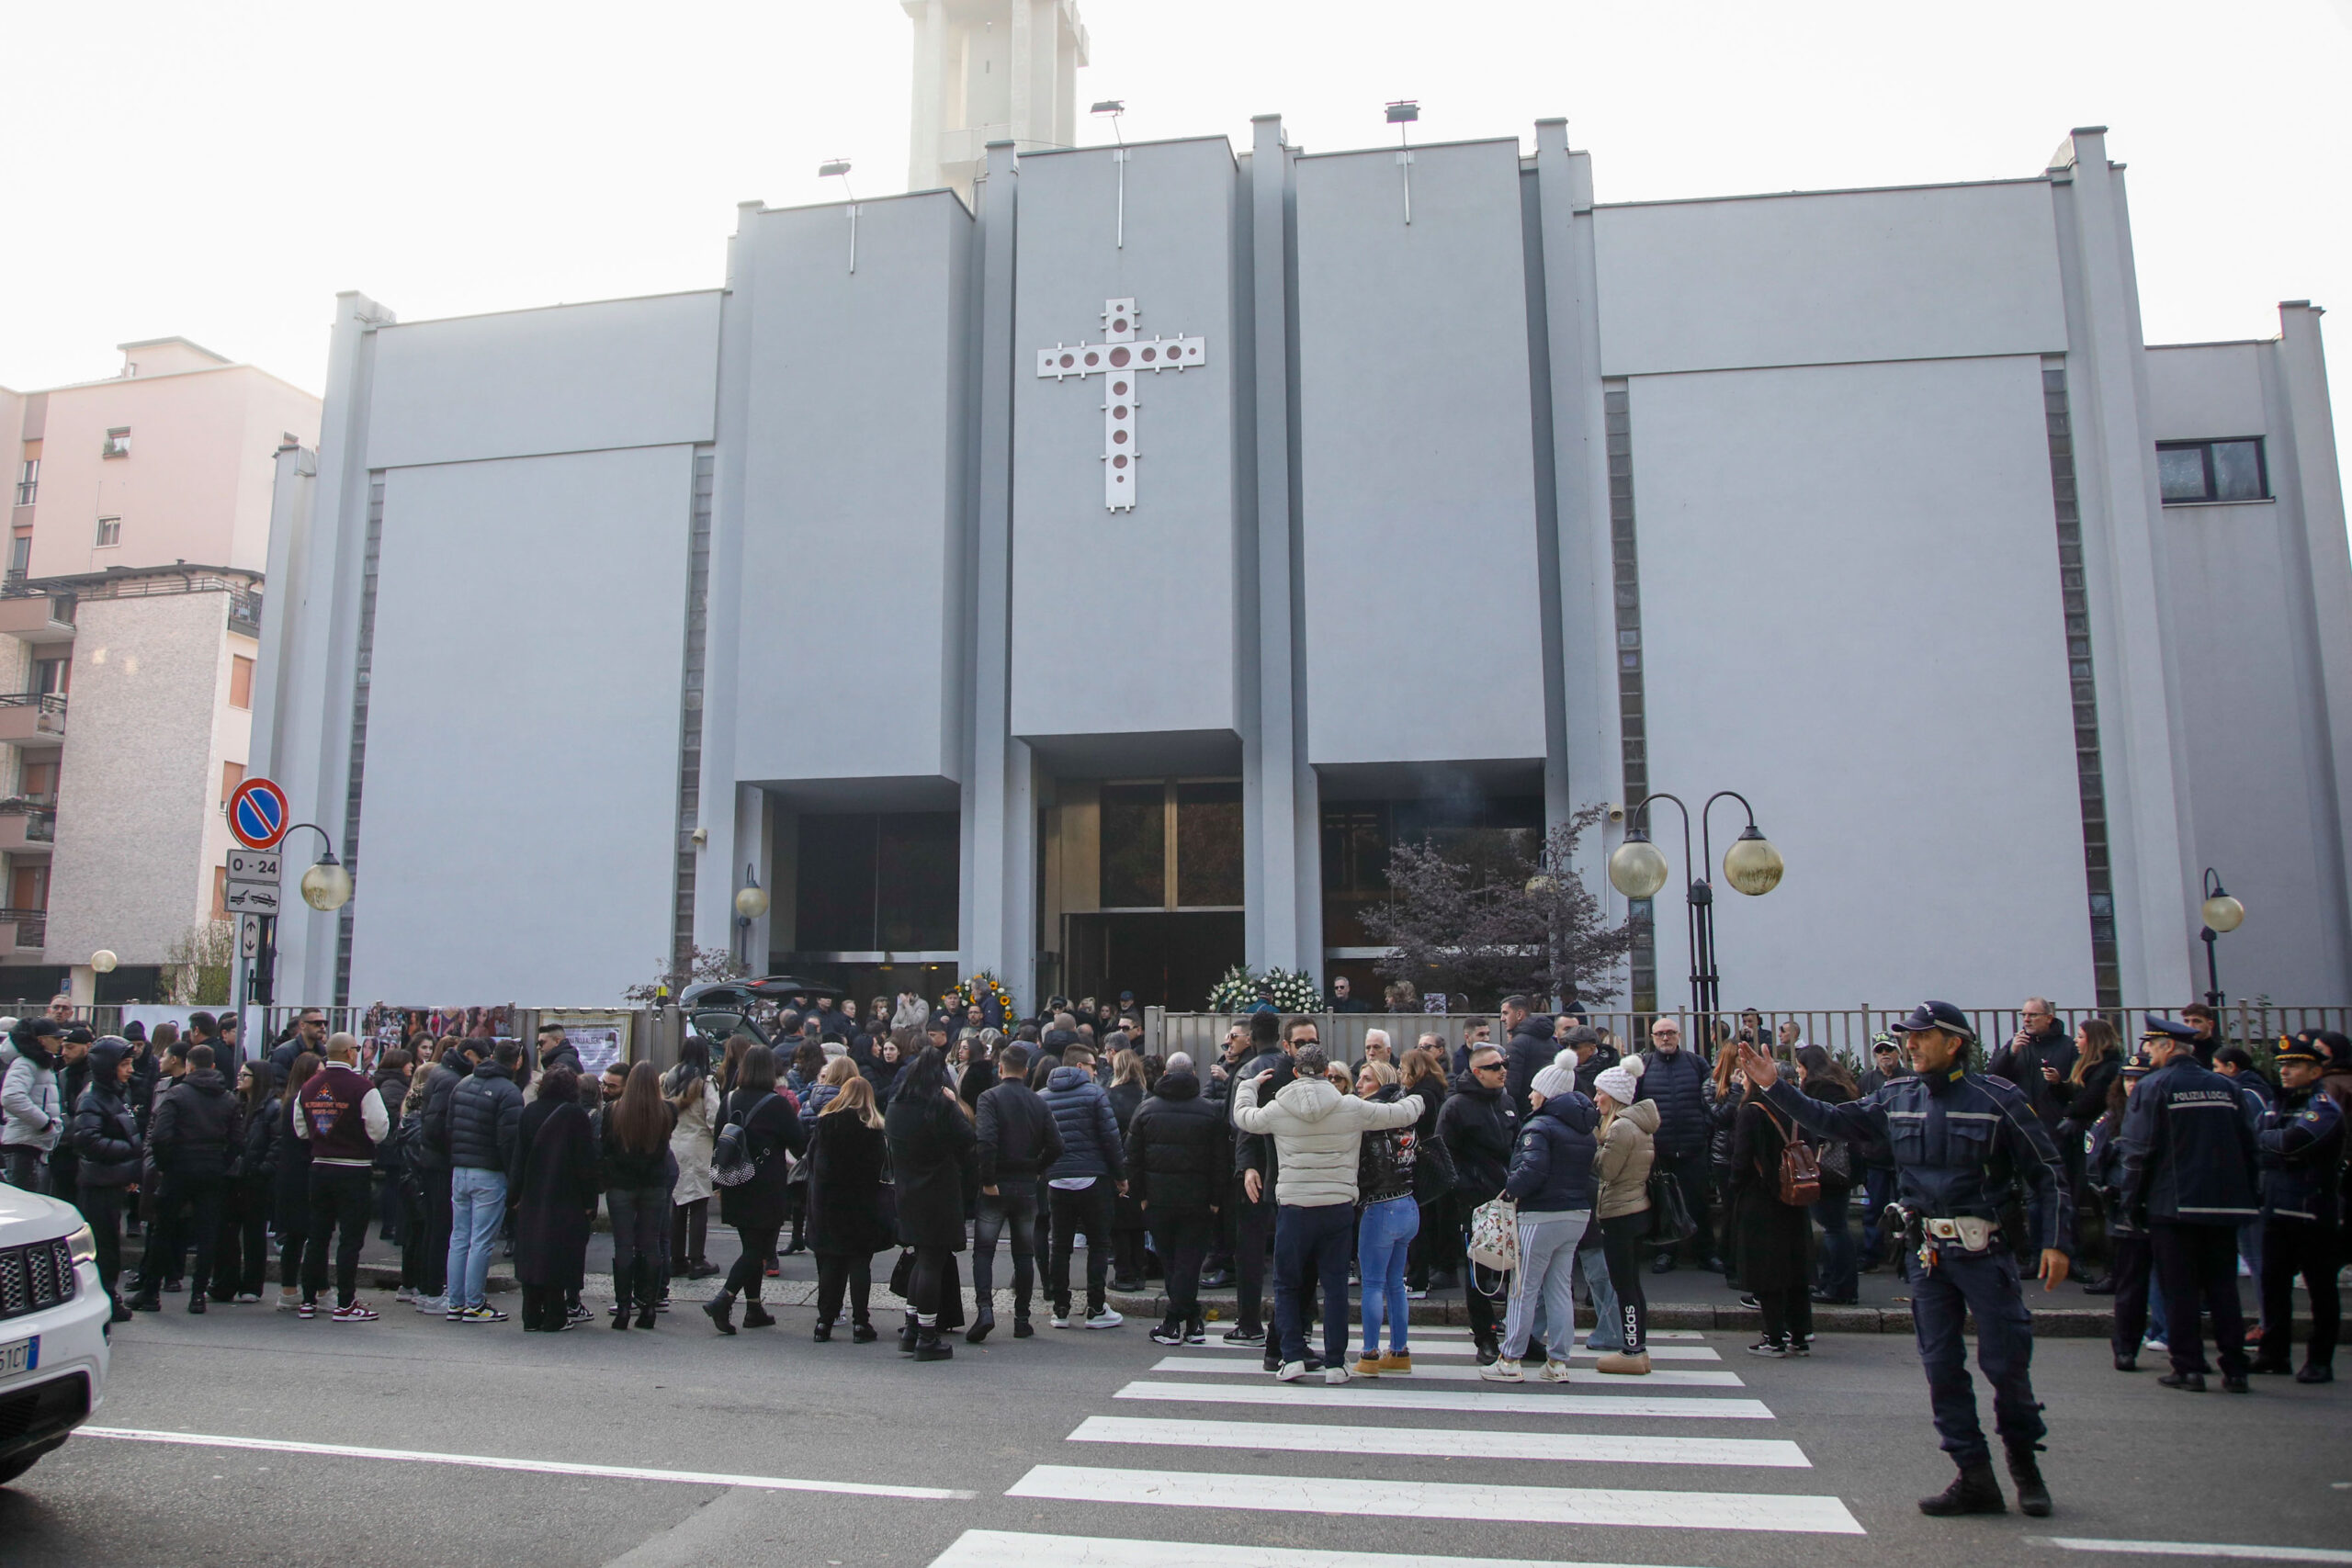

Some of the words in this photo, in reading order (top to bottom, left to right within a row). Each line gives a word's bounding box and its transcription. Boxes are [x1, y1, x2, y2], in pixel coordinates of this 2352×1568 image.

[258, 860, 277, 874] 24
[2173, 1090, 2206, 1102] POLIZIA
[1624, 1305, 1637, 1347] adidas
